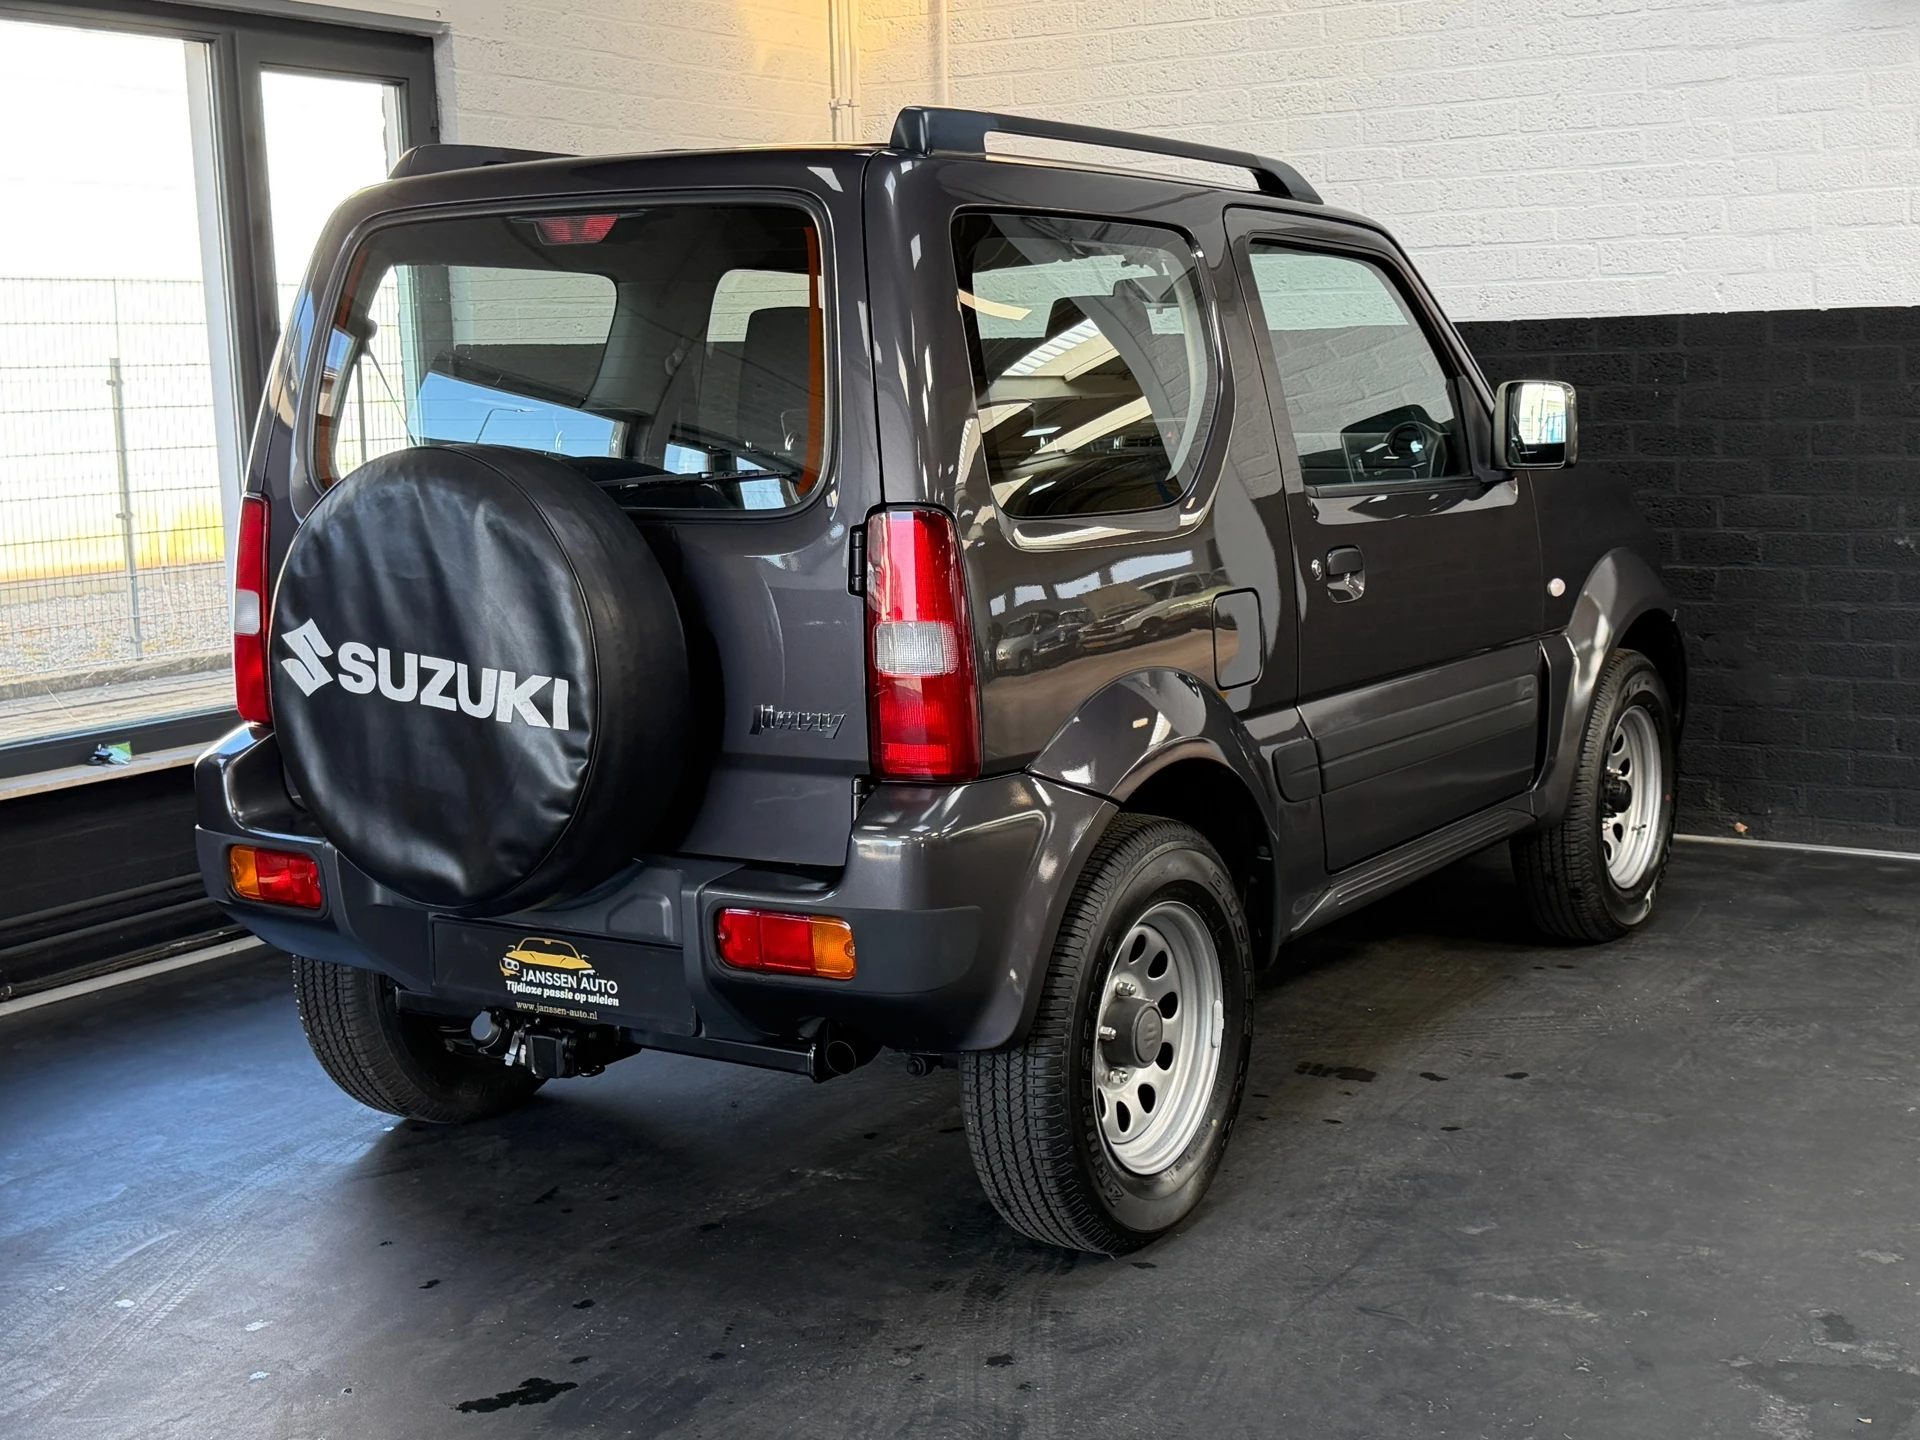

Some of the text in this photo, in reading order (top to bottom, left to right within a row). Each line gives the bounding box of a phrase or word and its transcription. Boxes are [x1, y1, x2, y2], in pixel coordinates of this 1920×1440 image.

[337, 641, 570, 731] SUZUKI
[505, 980, 620, 1007] Tijdloze passie op wielen
[521, 968, 619, 994] JANSSEN AUTO
[515, 1000, 598, 1020] www.janssen-auto.nl
